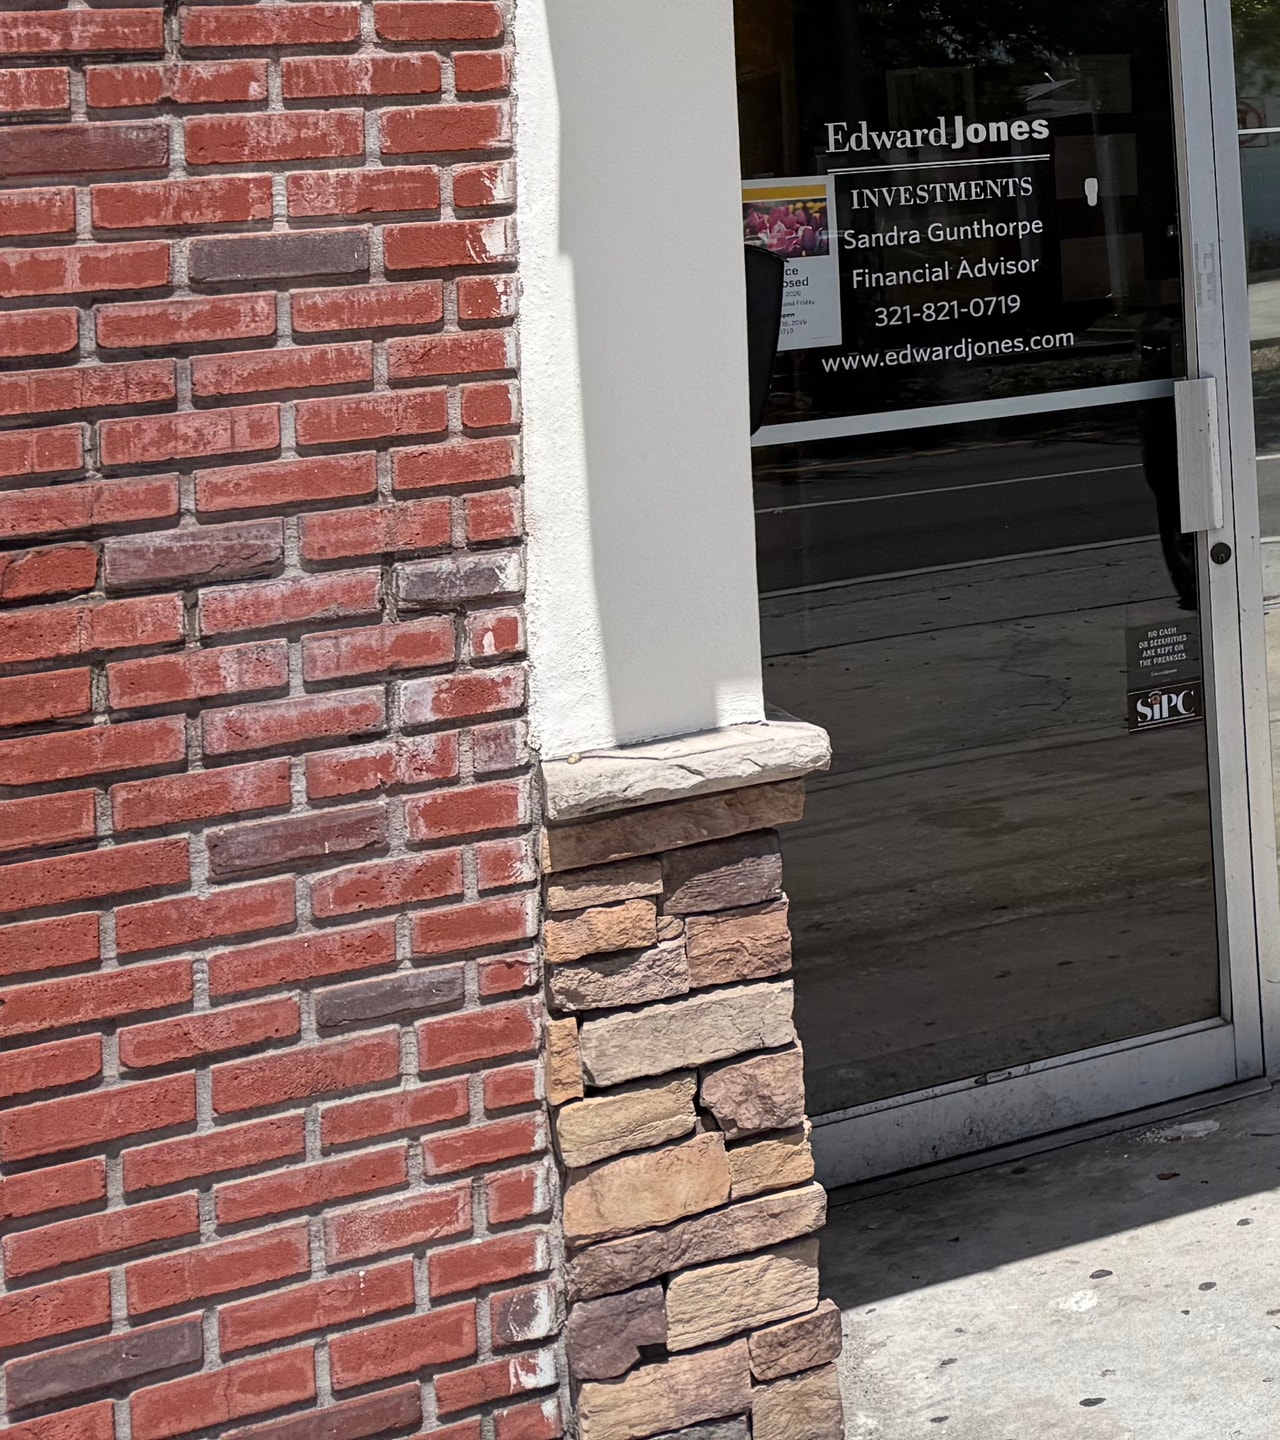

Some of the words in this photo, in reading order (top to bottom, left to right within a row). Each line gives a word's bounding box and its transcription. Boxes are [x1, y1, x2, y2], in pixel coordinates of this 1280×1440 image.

[850, 176, 1034, 210] INVESTMENTS
[843, 221, 921, 251] Sandra
[927, 216, 1044, 246] Gunthorpe
[852, 260, 951, 290] Financial
[956, 255, 1040, 281] Advisor
[874, 294, 1022, 327] 321-821-0719
[821, 327, 1076, 374] www.edwardjones.com
